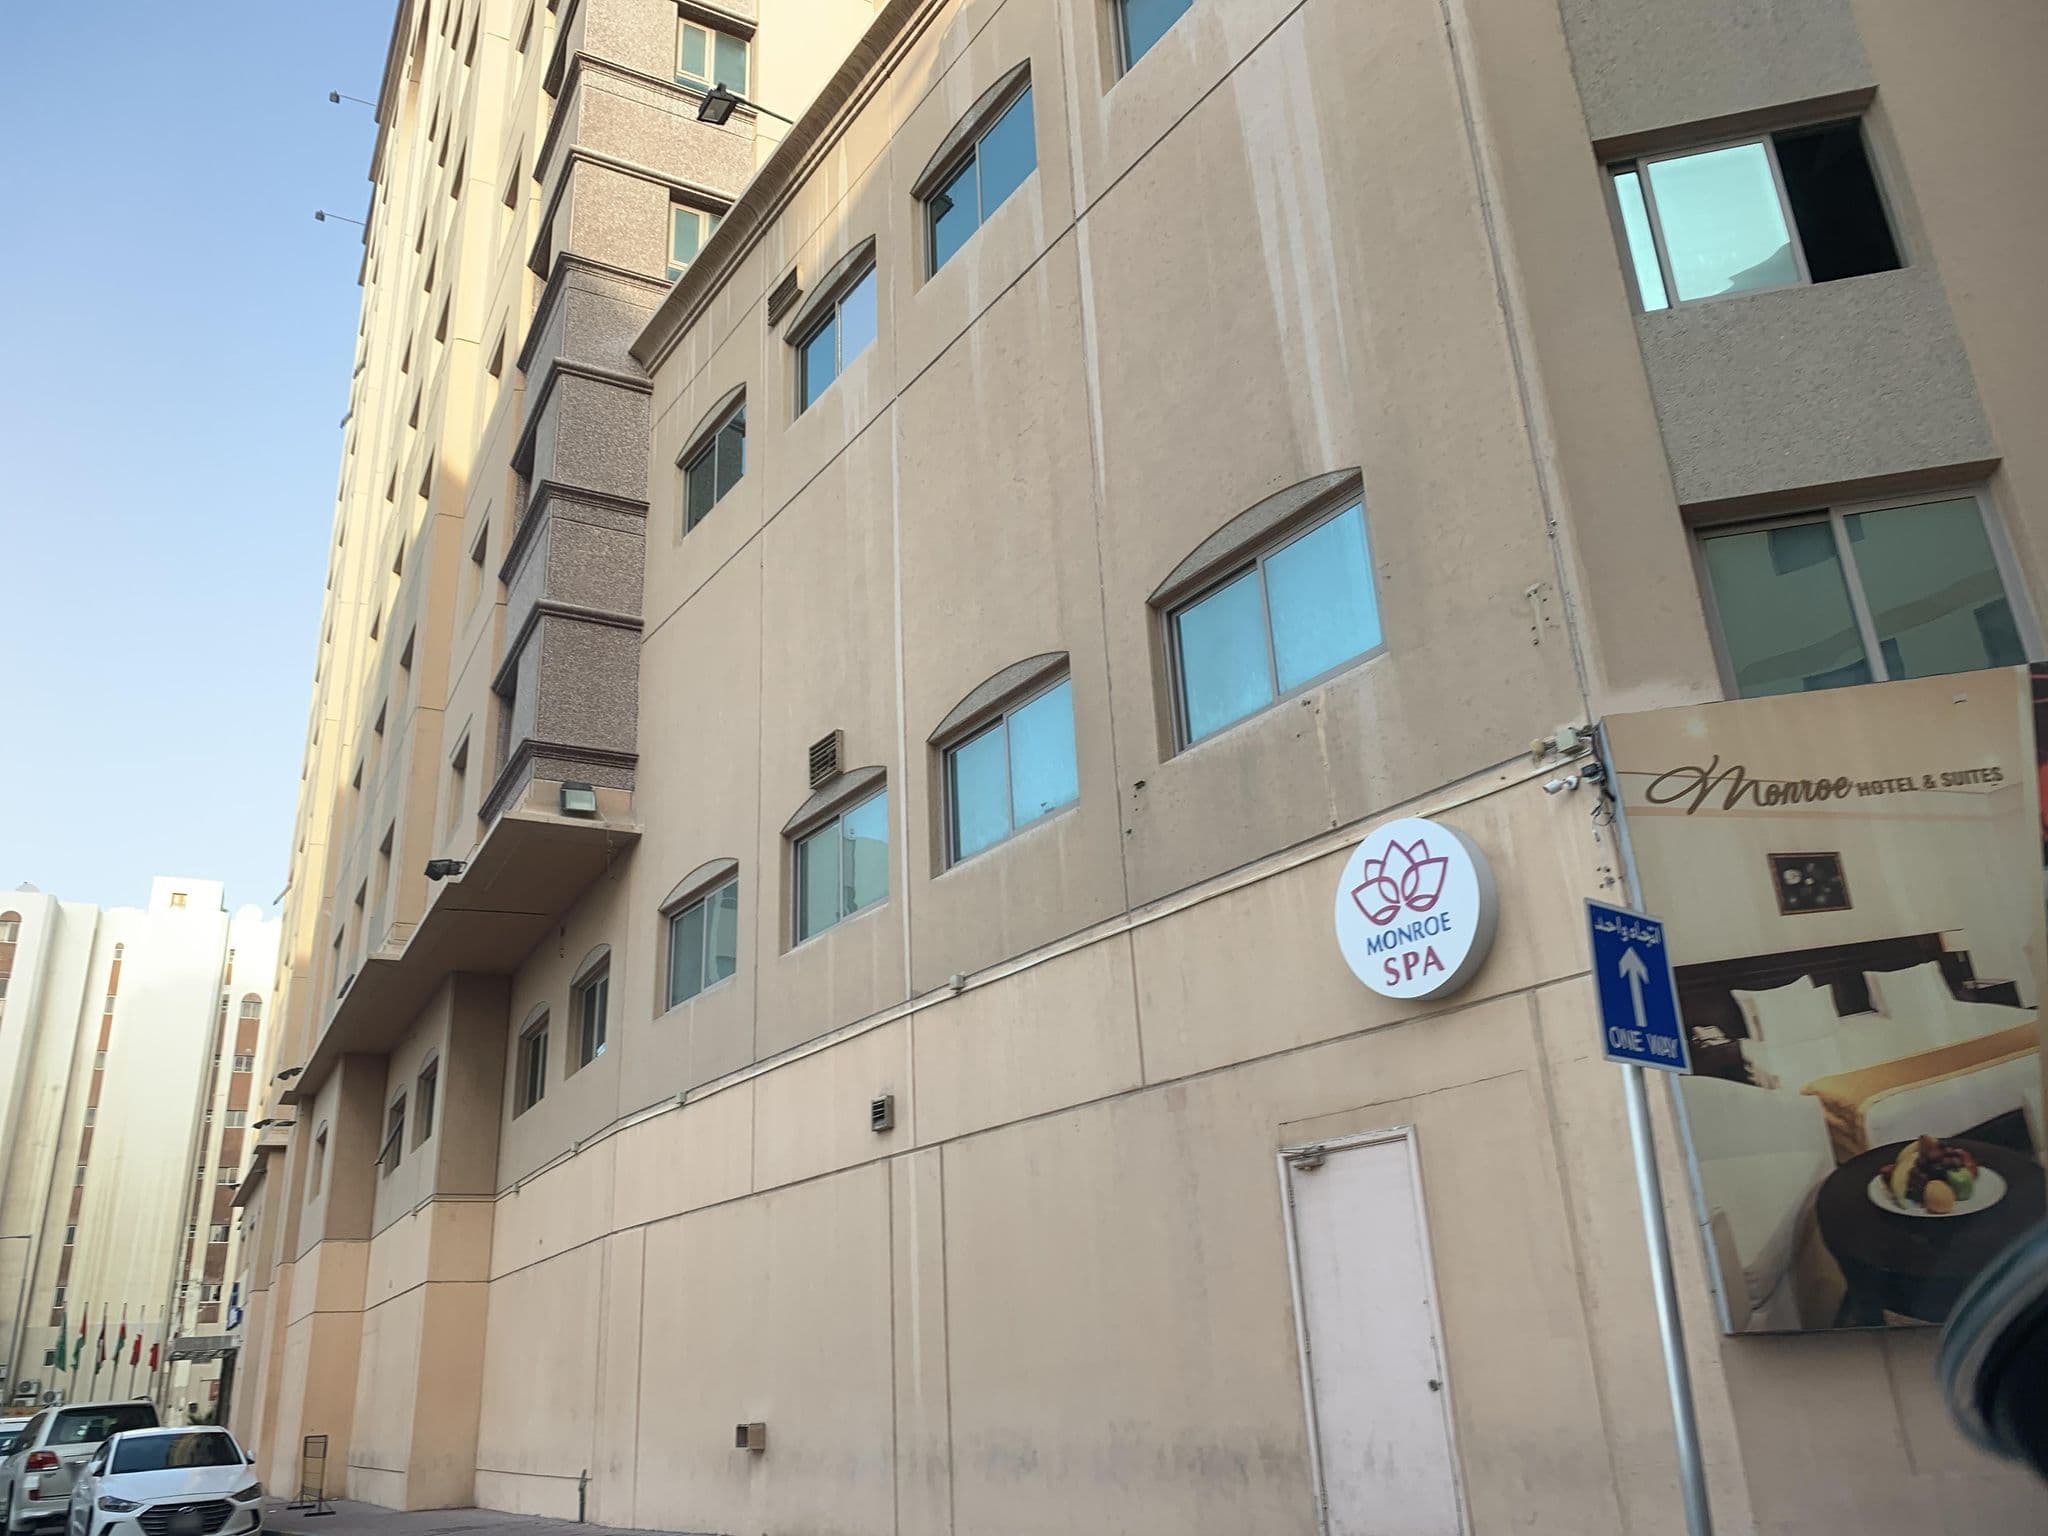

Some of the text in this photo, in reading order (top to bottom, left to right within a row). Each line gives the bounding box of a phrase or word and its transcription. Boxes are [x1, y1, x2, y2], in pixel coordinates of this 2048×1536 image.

[1645, 754, 2005, 816] Monroe HOTEL & SUITES
[1366, 911, 1452, 956] MONROE
[1594, 915, 1628, 942] واحد
[1383, 945, 1446, 988] SPA
[1609, 1025, 1679, 1059] ONE WAY
